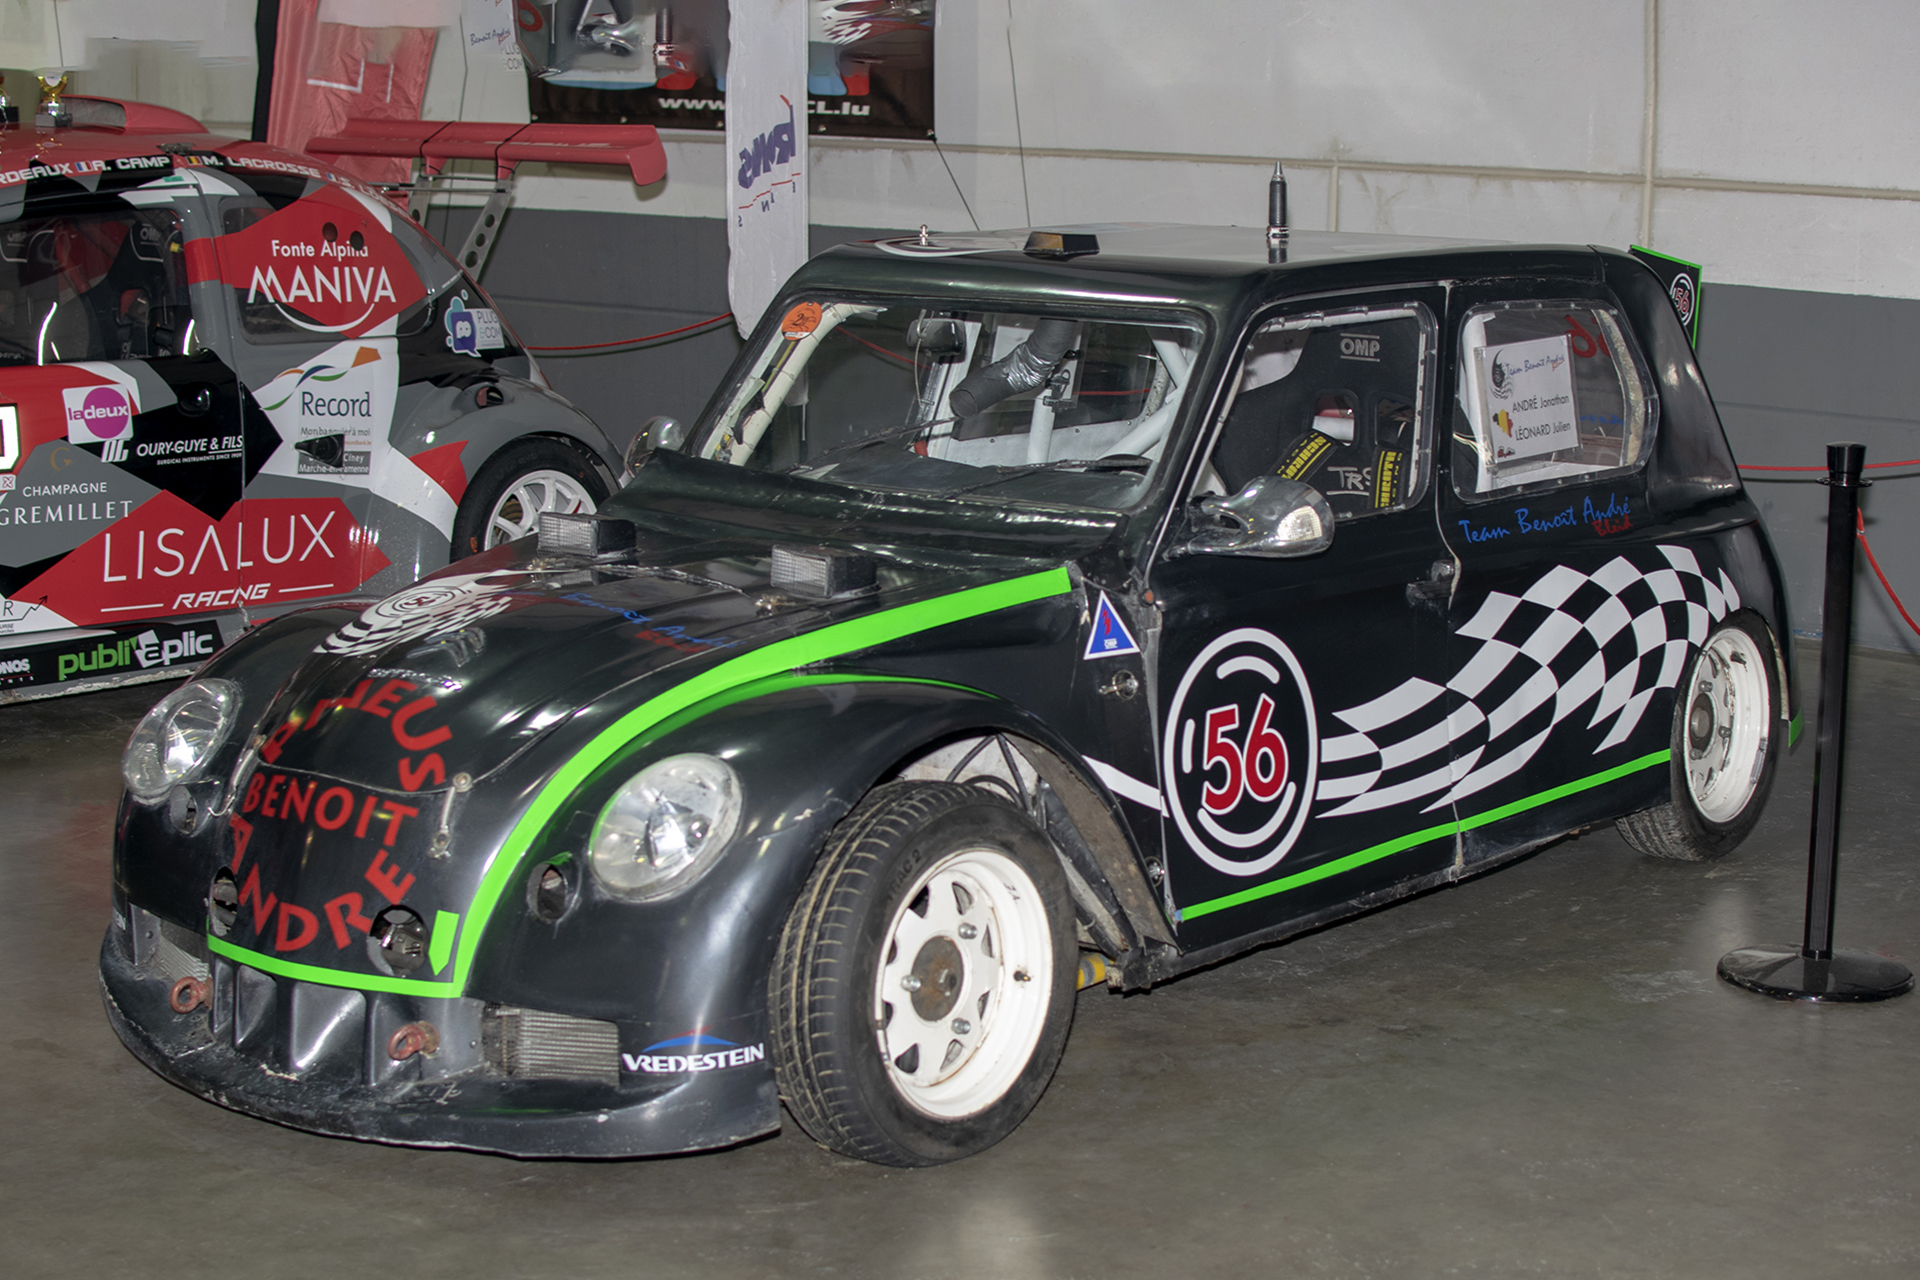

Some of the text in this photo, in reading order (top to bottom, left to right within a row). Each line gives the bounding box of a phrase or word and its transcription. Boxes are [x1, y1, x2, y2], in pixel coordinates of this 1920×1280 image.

[116, 155, 171, 170] CAMP
[203, 155, 321, 179] M. LACROSSE
[272, 240, 315, 257] Fonte
[247, 265, 397, 304] MANIVA
[1340, 338, 1380, 357] OMP
[302, 391, 372, 417] Record
[1512, 394, 1538, 413] ANDRÉ
[1515, 422, 1551, 441] LÉONARD
[136, 437, 208, 456] OURY-GUYE
[209, 436, 220, 450] &
[221, 434, 243, 449] FILS
[22, 481, 107, 498] CHAMPAGNE
[1458, 519, 1510, 543] Team
[104, 511, 336, 583] LISALUX
[1201, 692, 1289, 816] 56
[242, 772, 420, 847] BENOIT
[229, 812, 416, 952] ANDRE
[622, 1042, 765, 1073] VREDESTEIN
